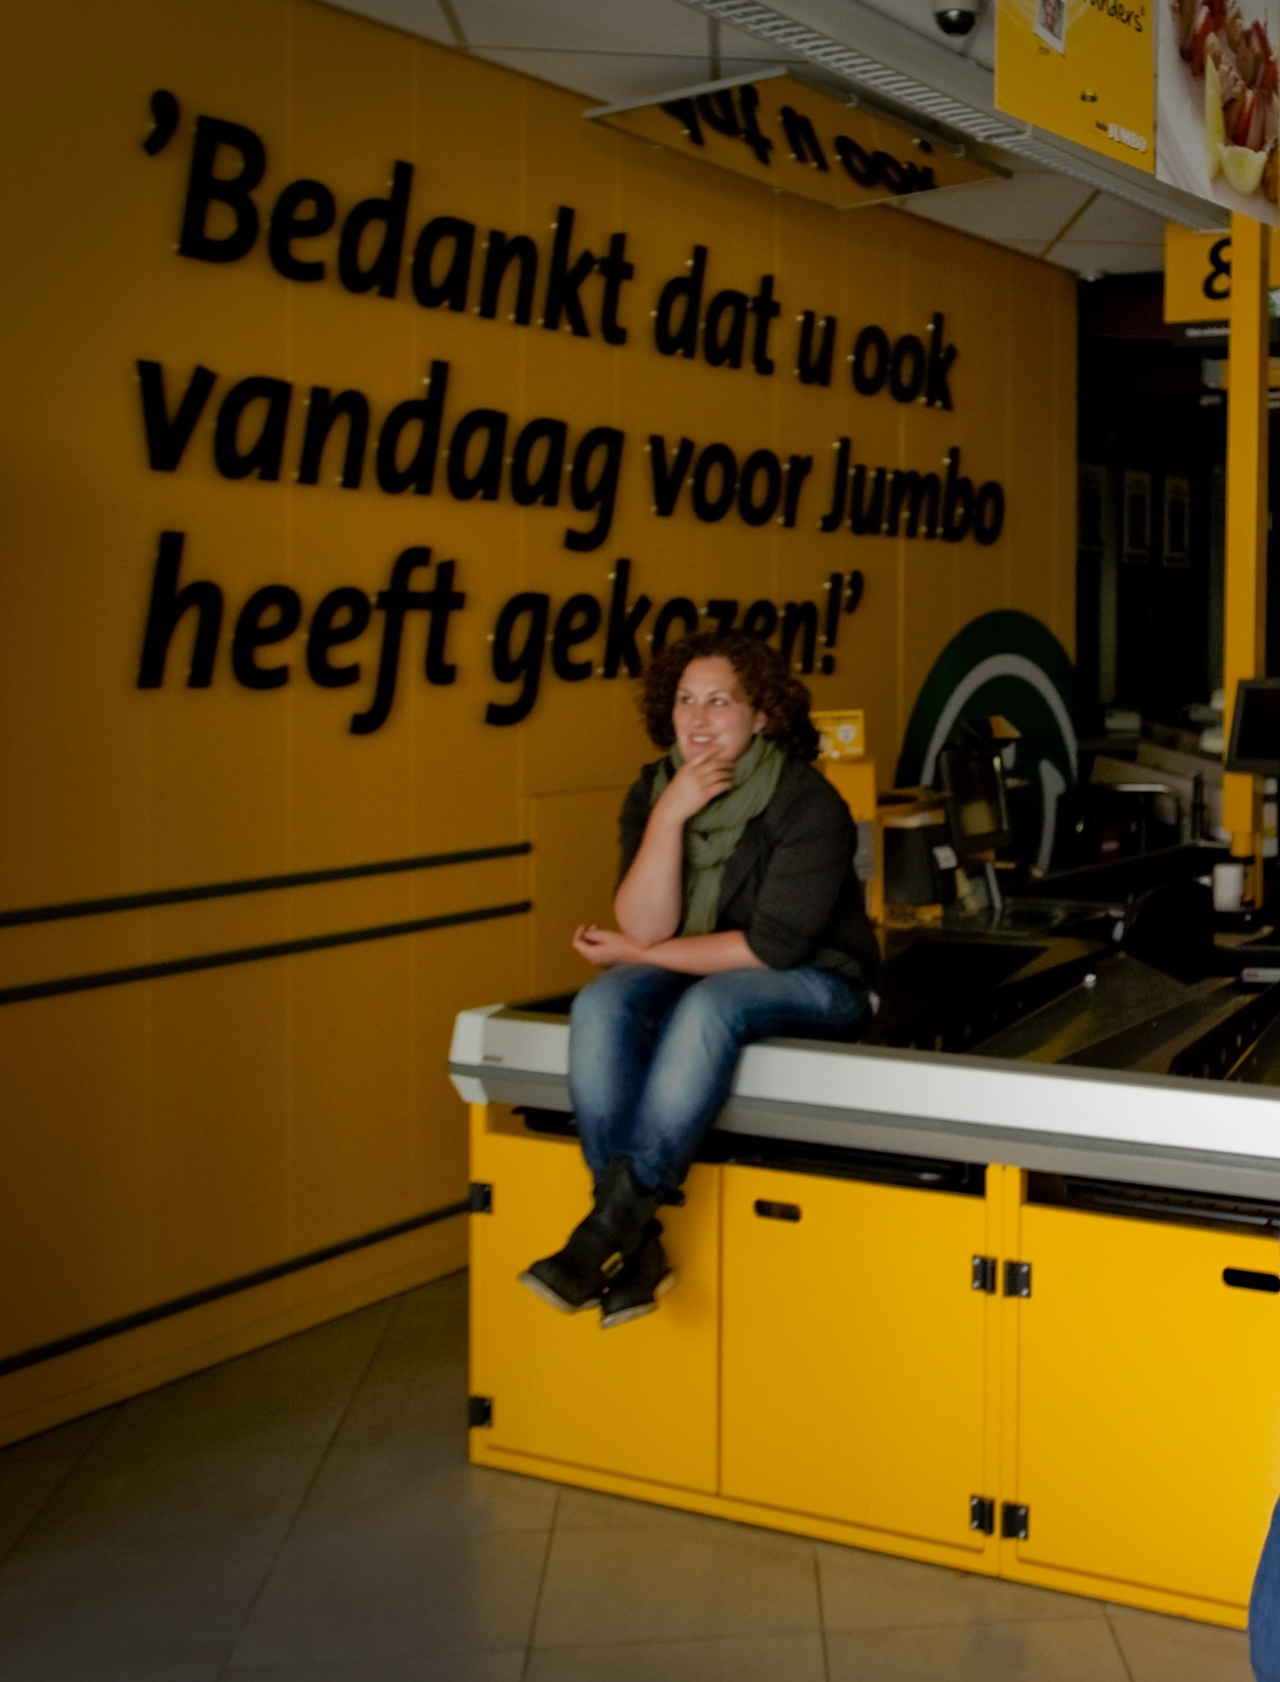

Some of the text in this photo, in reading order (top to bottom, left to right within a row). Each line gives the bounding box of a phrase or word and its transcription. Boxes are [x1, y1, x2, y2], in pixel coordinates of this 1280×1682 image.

[143, 90, 957, 411] ’Bedankt dat u ook
[1204, 238, 1231, 300] 8
[136, 359, 1006, 552] vandaag voor Jumbo
[136, 530, 466, 736] heeft
